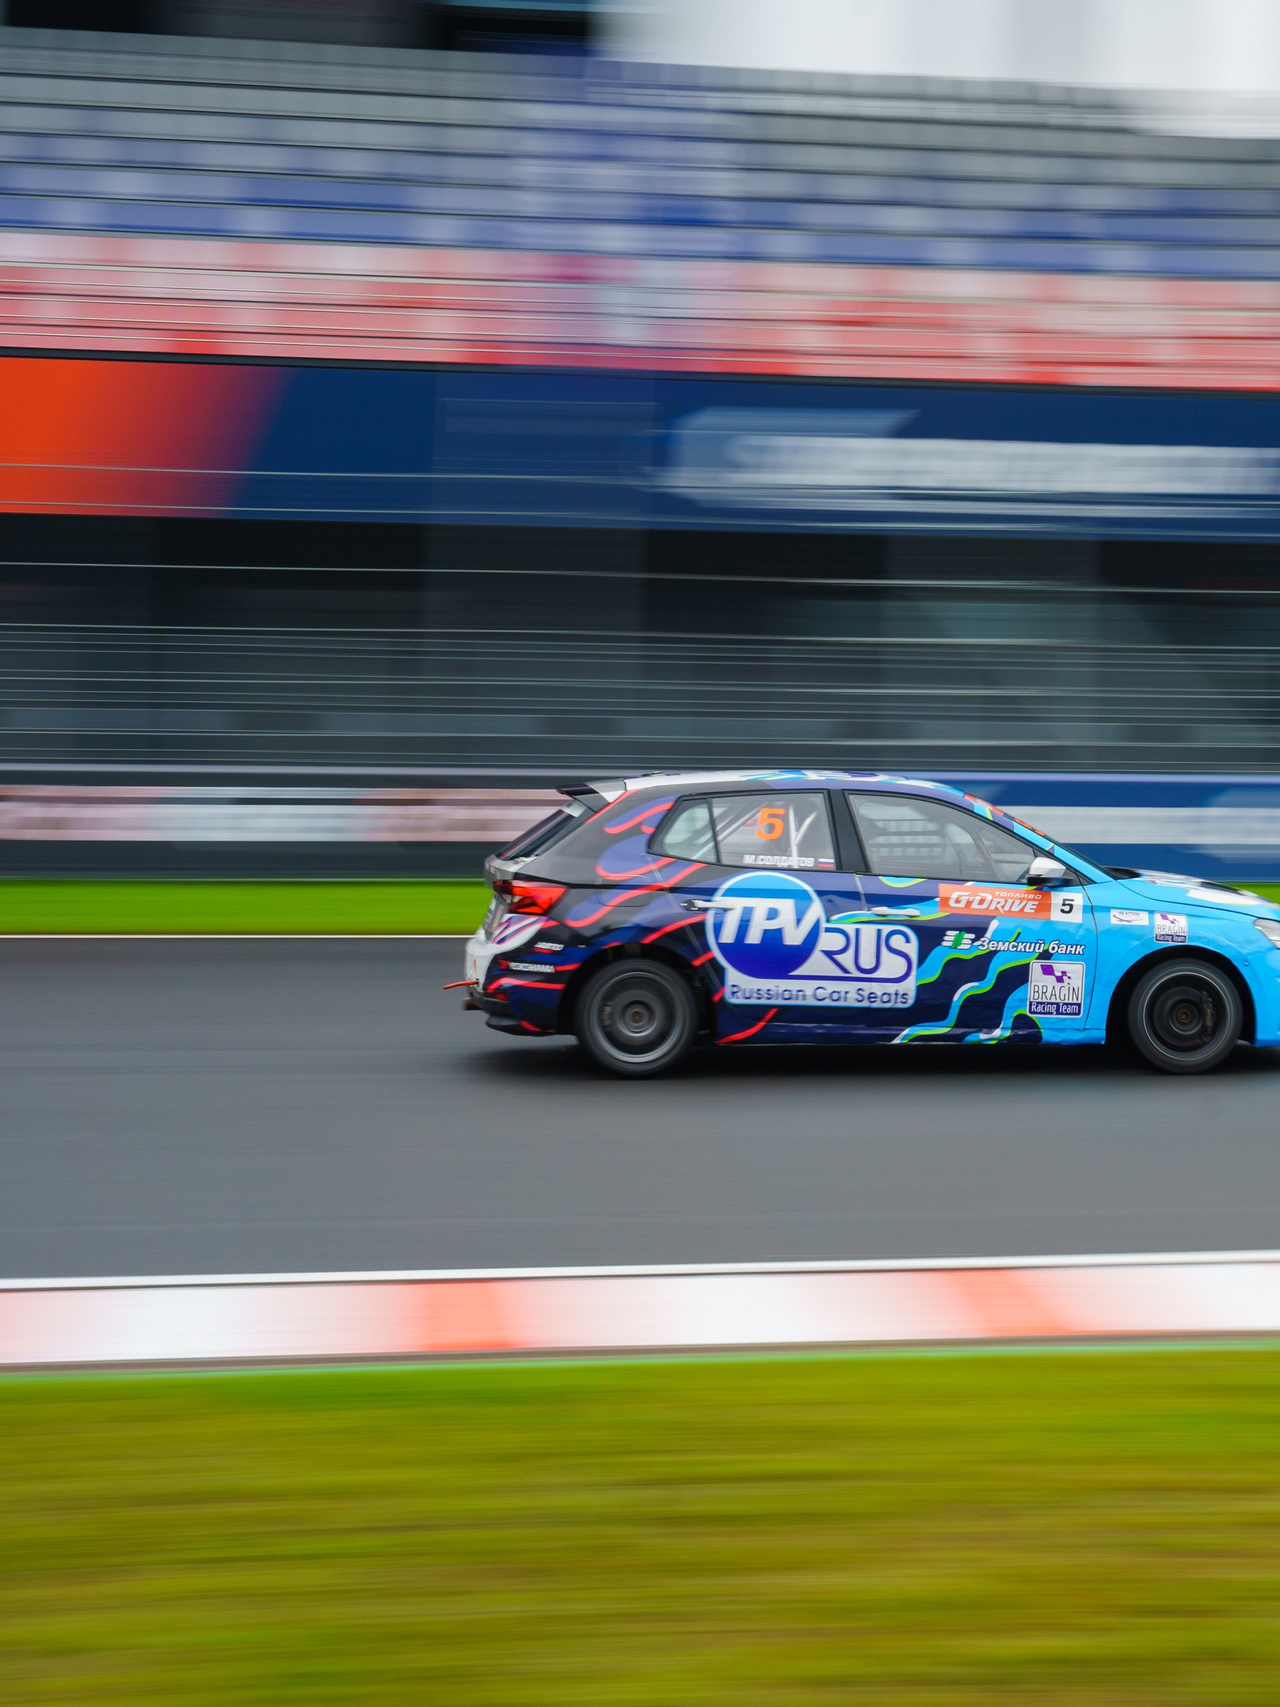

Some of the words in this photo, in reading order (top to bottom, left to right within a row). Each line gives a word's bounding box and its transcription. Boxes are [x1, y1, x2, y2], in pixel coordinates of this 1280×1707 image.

[756, 808, 786, 840] 5
[994, 891, 1043, 900] ТОПЛИВО
[1060, 898, 1075, 915] 5
[716, 896, 822, 946] TPV
[819, 927, 913, 983] RUS
[978, 938, 1046, 953] Земский
[1048, 941, 1086, 955] банк
[730, 985, 807, 1002] Russian
[811, 986, 850, 1002] Car
[854, 987, 910, 1004] Seats
[1031, 1002, 1057, 1016] Racing
[1059, 1003, 1079, 1014] Team
